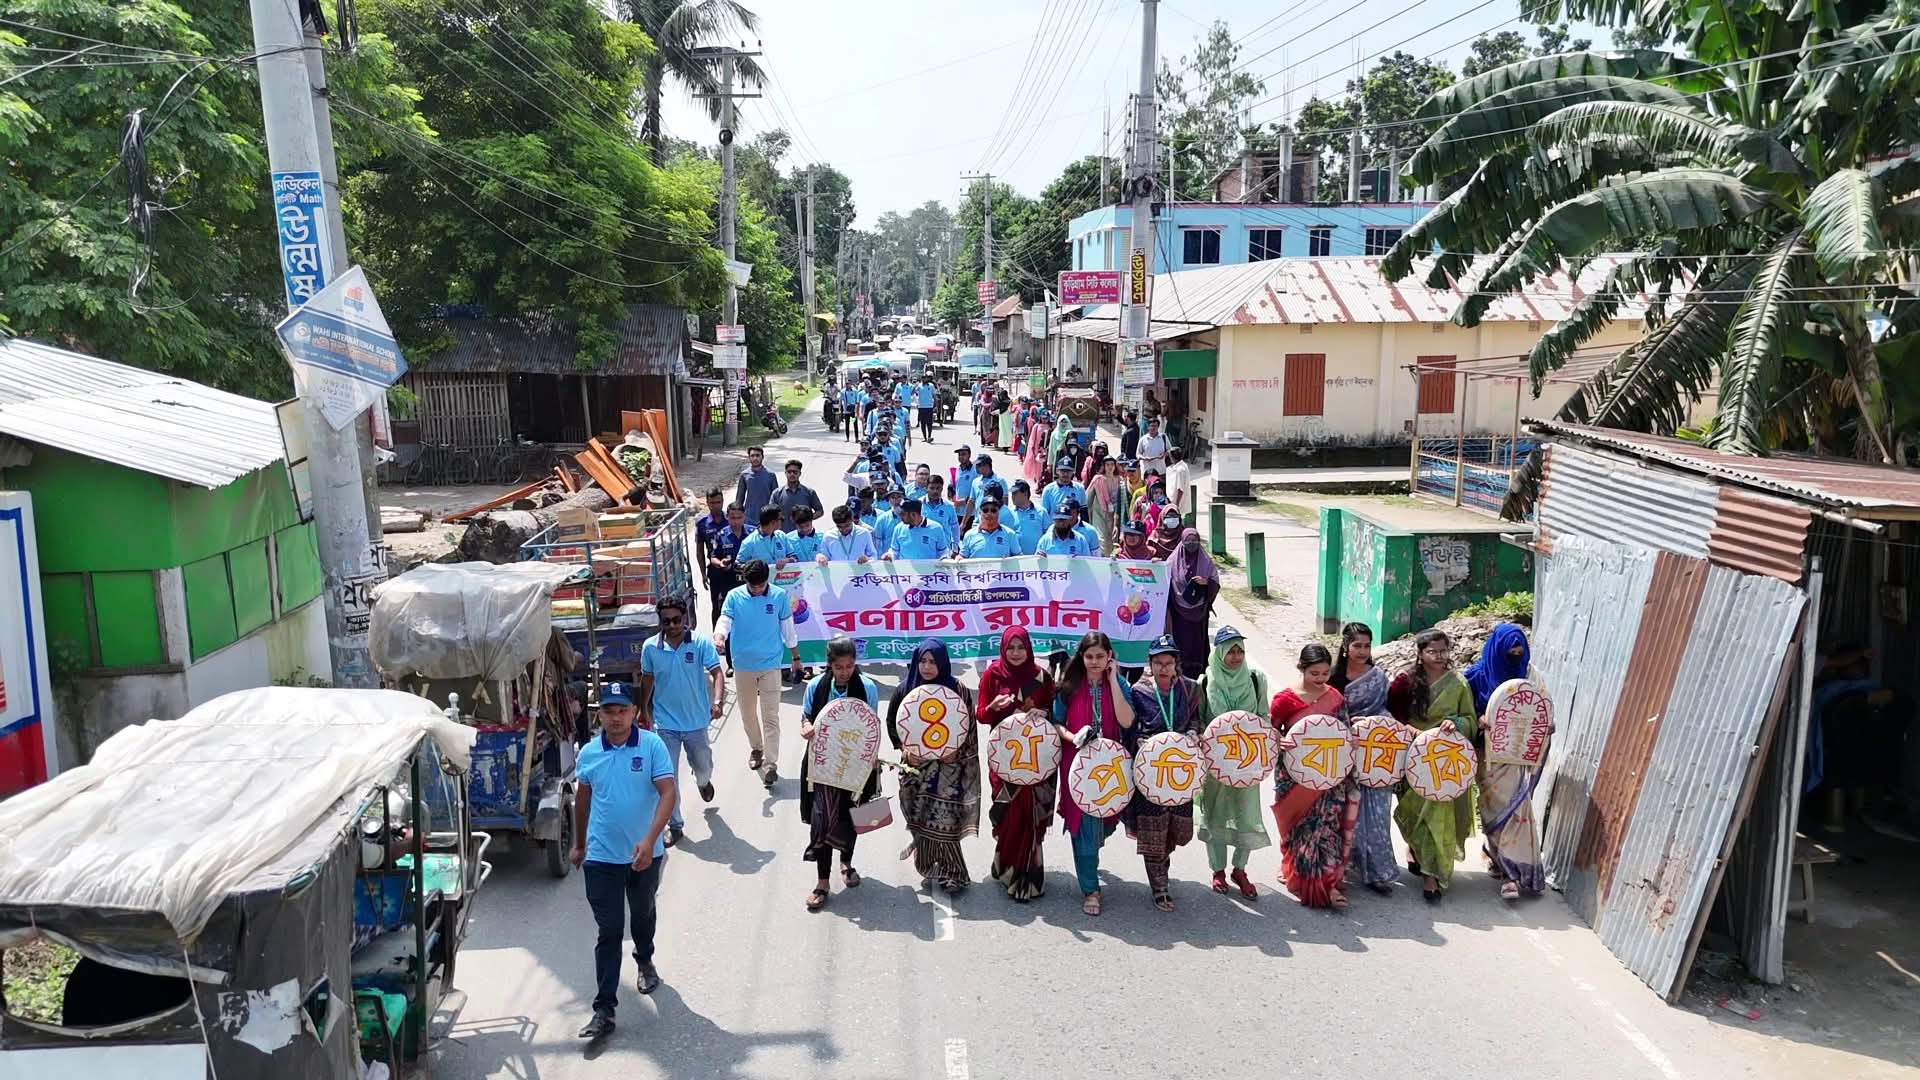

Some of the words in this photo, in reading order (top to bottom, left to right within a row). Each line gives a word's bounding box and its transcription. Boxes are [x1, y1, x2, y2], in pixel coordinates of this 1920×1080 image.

[849, 572, 912, 587] কুড়িগ্রাম
[920, 572, 951, 587] কৃষি
[957, 570, 1070, 585] বিশ্ববিদ্যালয়ের
[823, 600, 966, 632] বর্ণাঢ্য
[1150, 747, 1197, 791] তি
[1301, 738, 1346, 778] বা
[1421, 738, 1472, 791] কি
